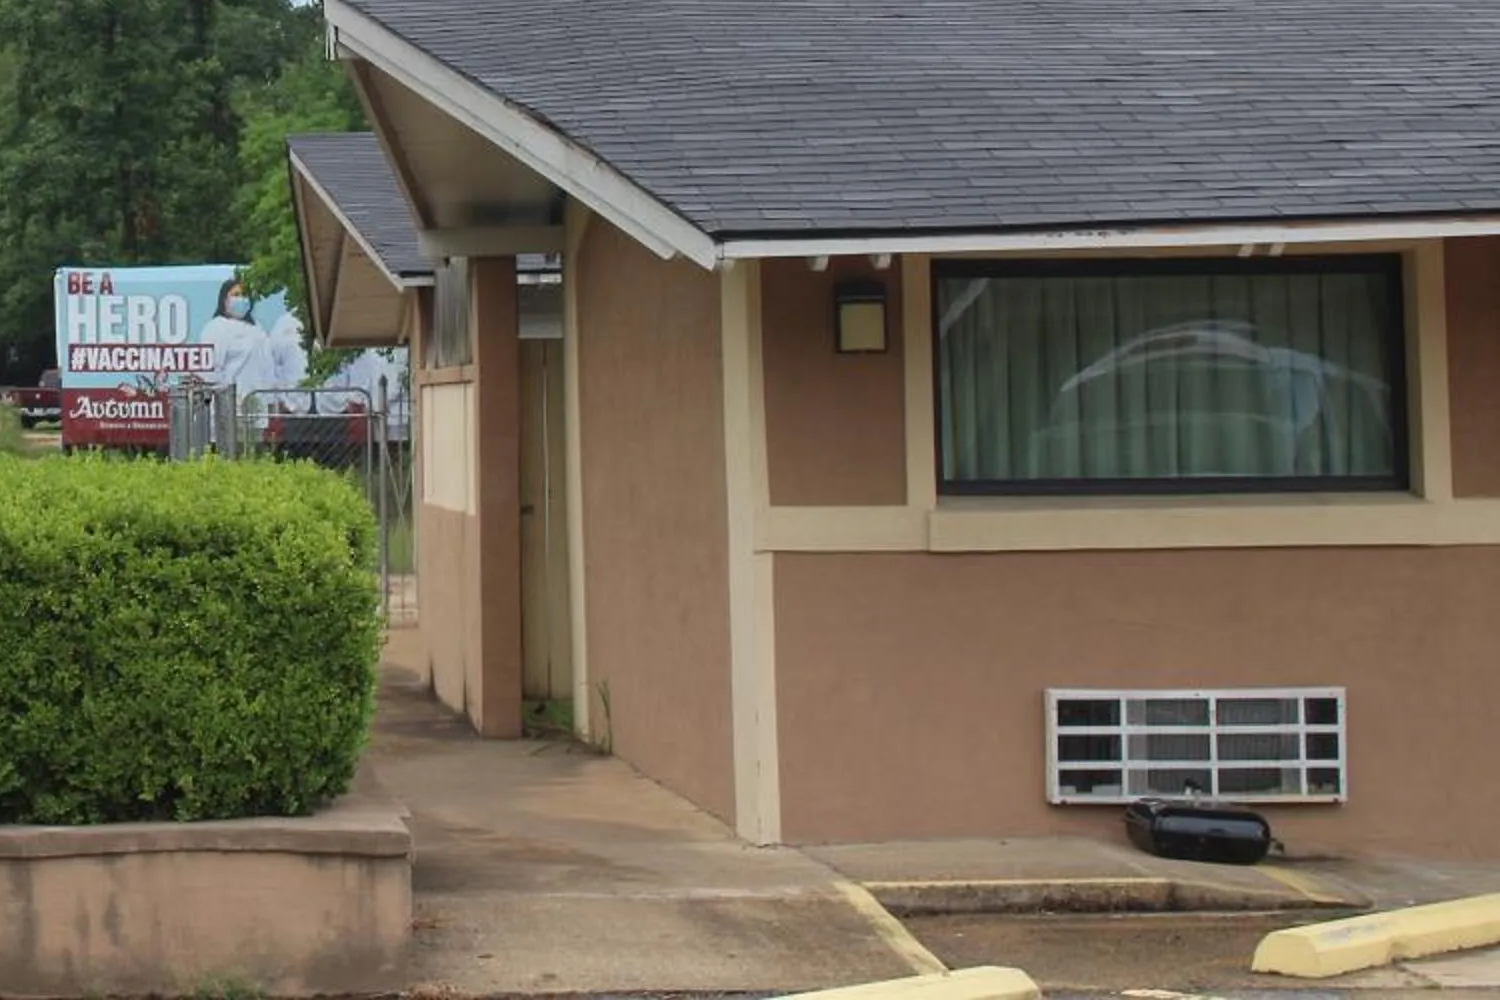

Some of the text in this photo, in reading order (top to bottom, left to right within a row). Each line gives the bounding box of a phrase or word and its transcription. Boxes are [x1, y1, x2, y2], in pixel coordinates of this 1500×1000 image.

[68, 272, 113, 294] BE A
[68, 294, 188, 344] HERO
[71, 347, 213, 370] #VACCINATED
